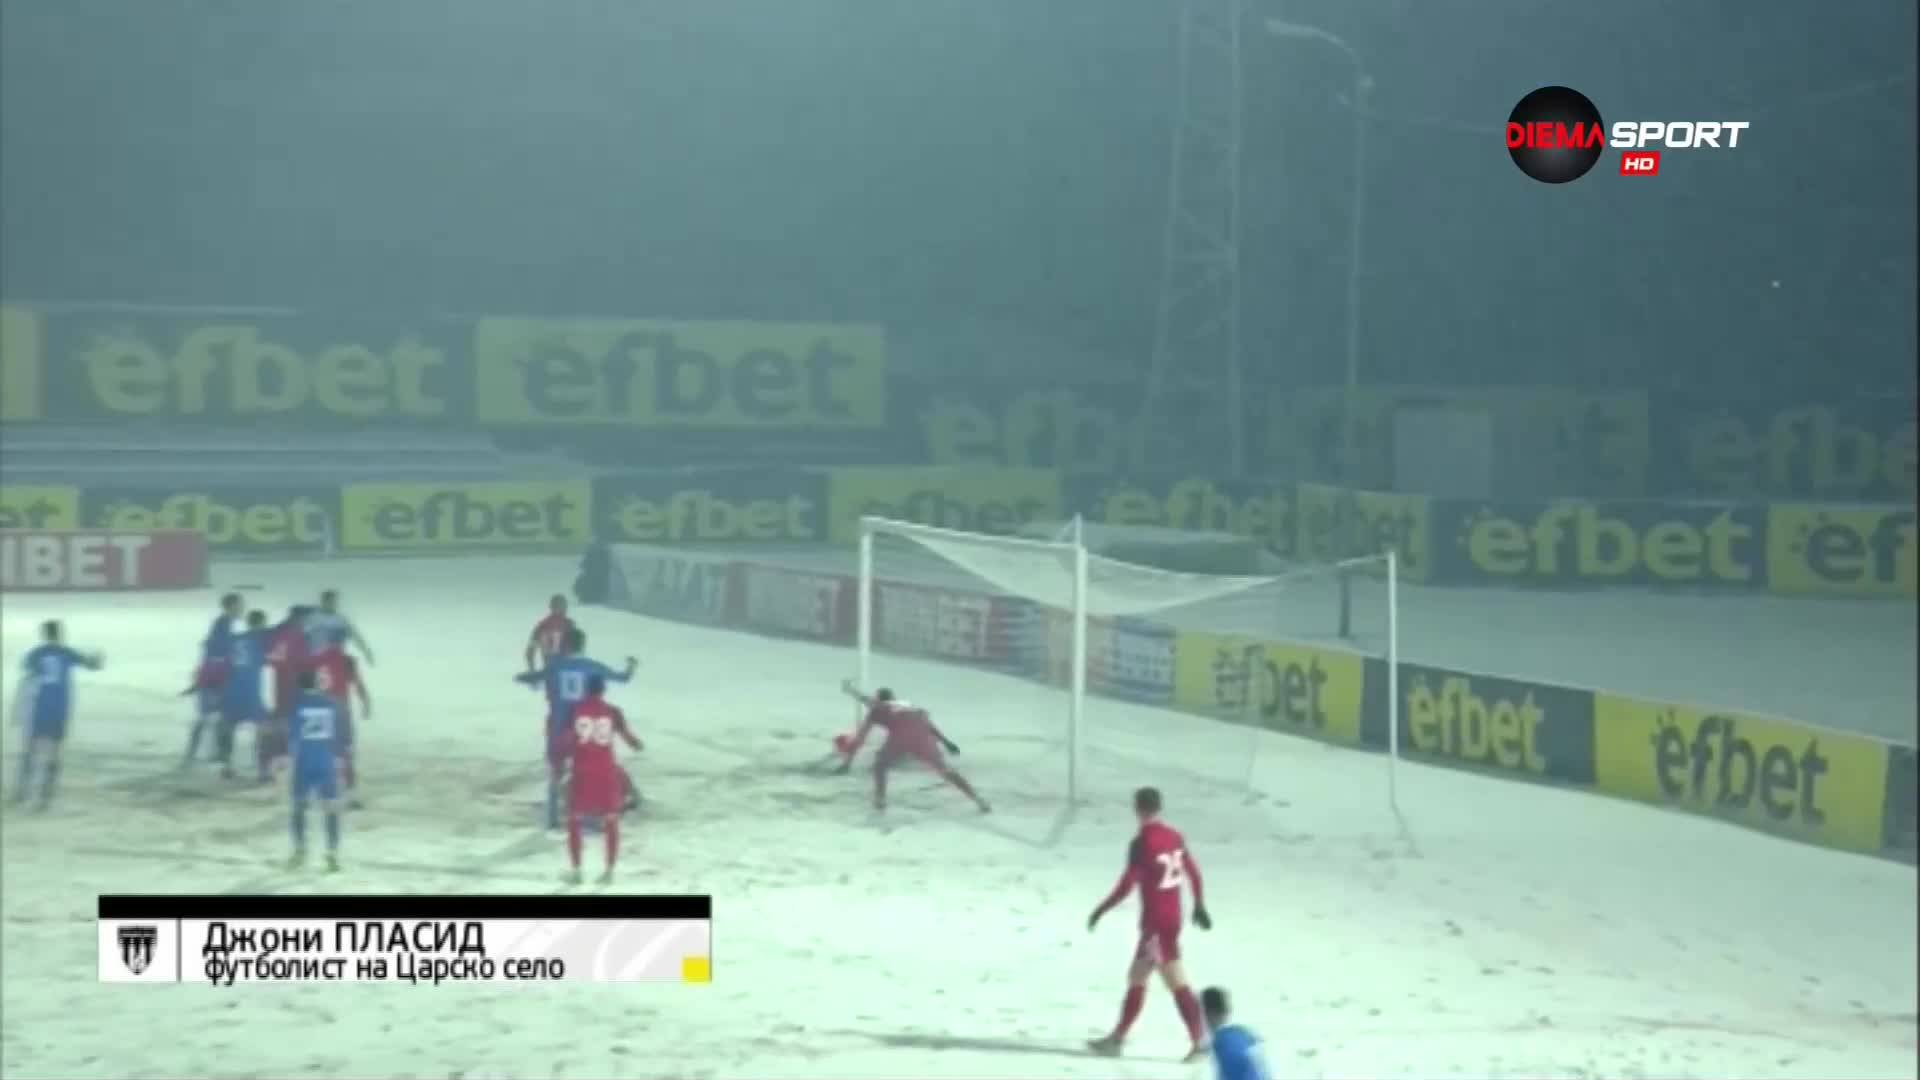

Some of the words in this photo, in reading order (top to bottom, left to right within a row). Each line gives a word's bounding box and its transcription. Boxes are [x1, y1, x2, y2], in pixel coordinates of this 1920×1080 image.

[87, 322, 446, 416] efbet
[525, 332, 858, 420] efbet
[371, 491, 578, 541] efbet
[618, 492, 814, 541] efbet
[1466, 502, 1750, 580] efbet
[574, 714, 613, 746] 98
[1212, 642, 1328, 730] efbet
[1403, 672, 1549, 770] efbet
[1650, 708, 1828, 826] efbet
